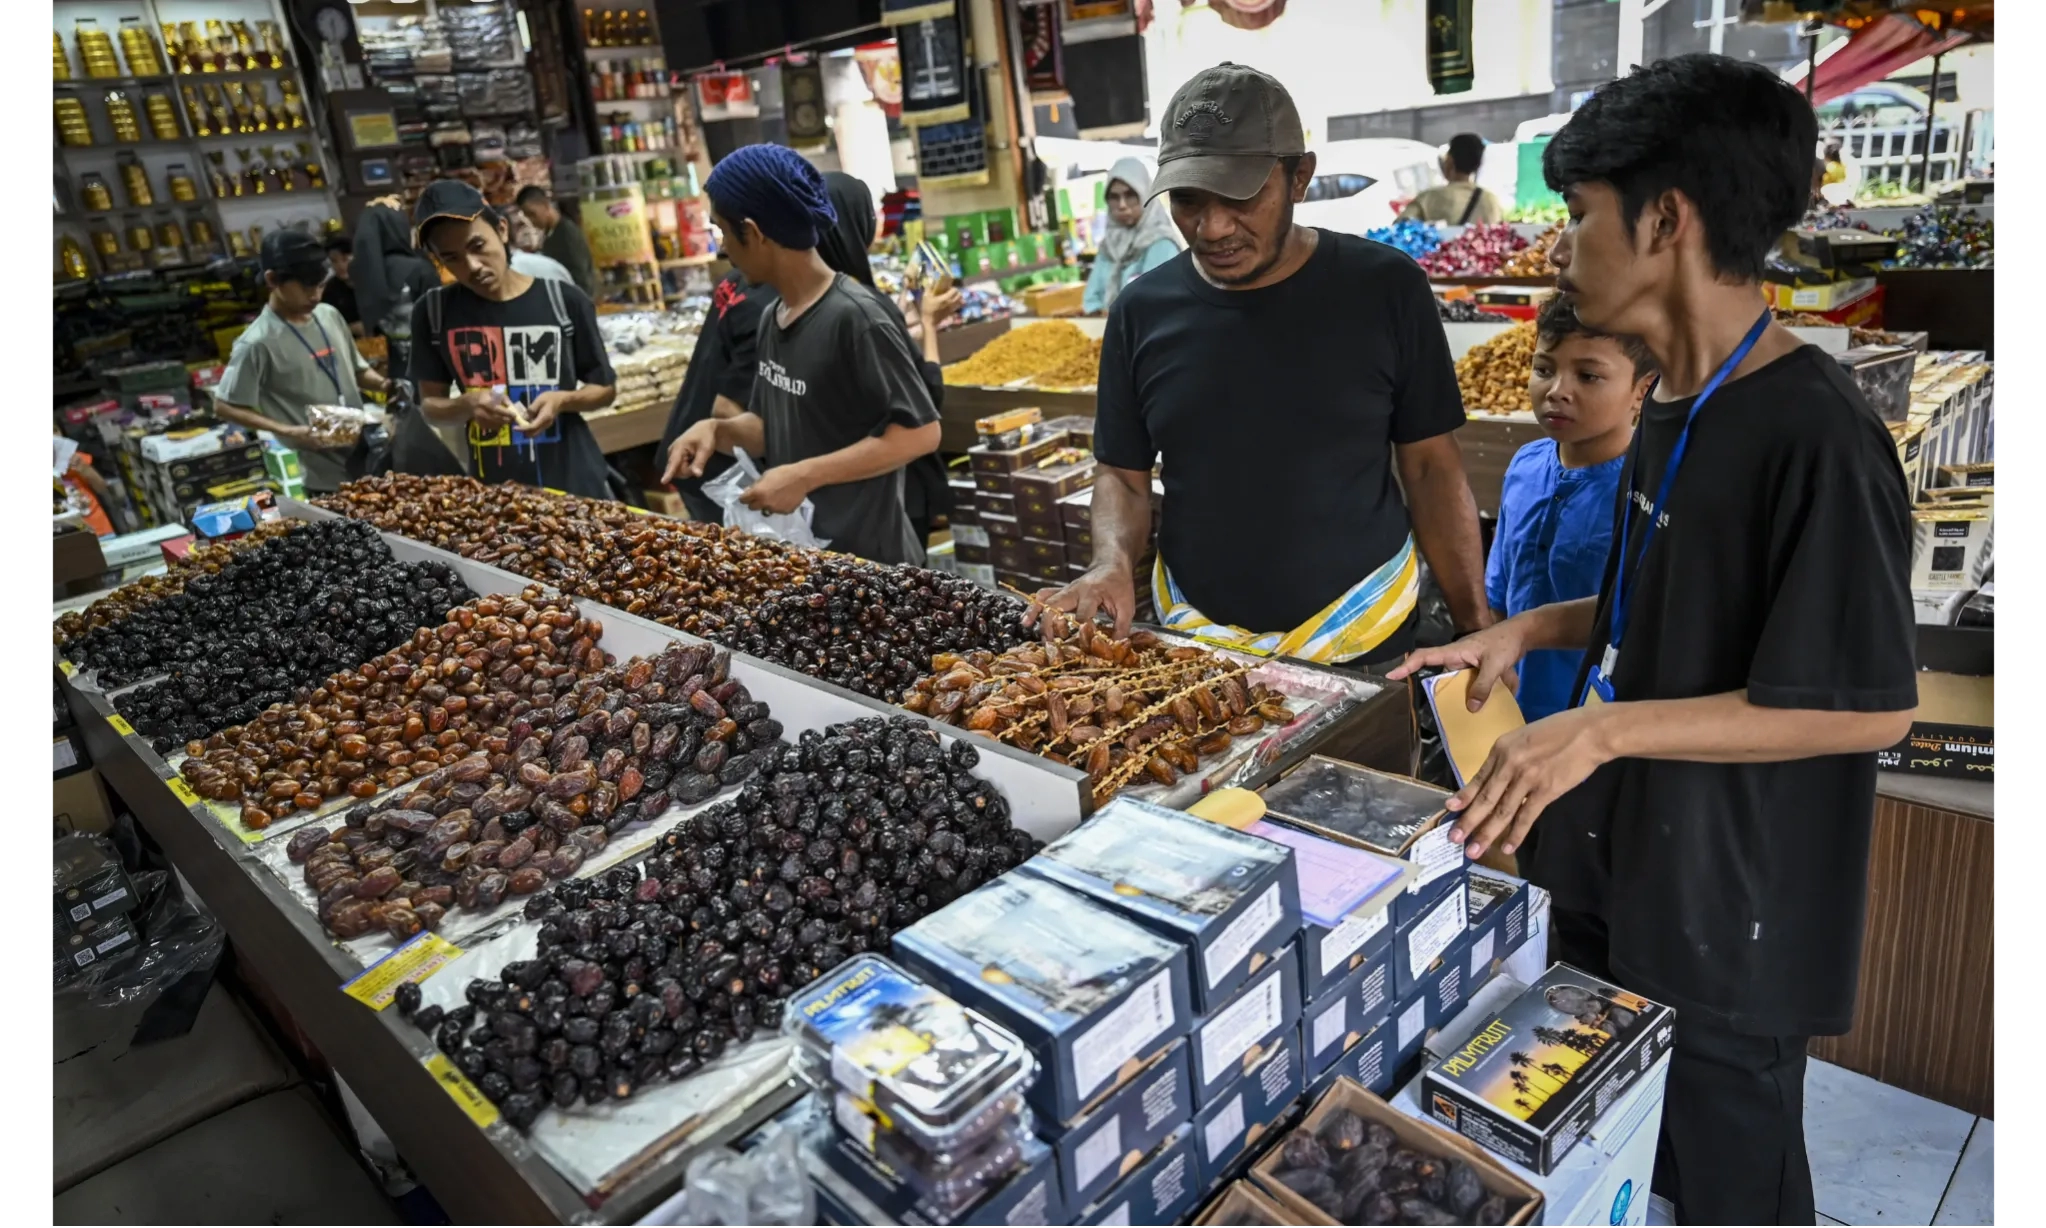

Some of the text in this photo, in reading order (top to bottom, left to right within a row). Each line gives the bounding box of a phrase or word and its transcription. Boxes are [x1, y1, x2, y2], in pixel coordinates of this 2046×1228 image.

[1911, 732, 1975, 743] QUALITY
[1910, 740, 1994, 756] mium Dates
